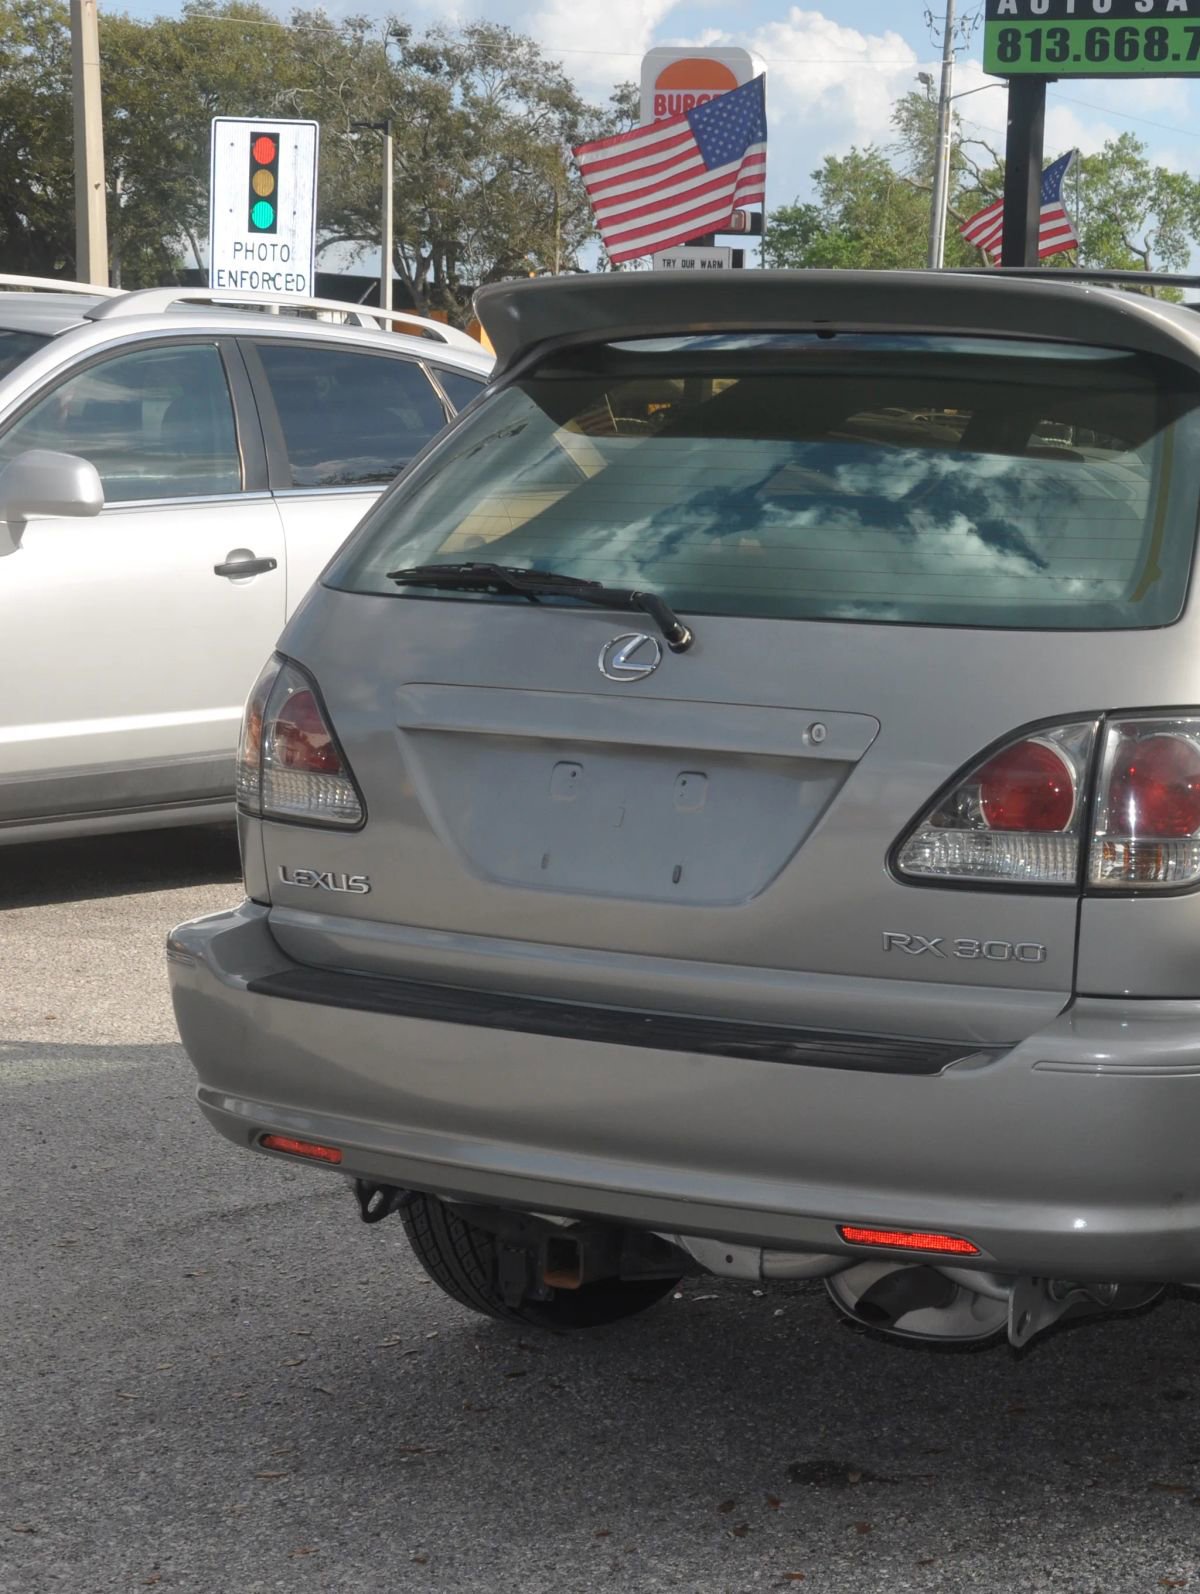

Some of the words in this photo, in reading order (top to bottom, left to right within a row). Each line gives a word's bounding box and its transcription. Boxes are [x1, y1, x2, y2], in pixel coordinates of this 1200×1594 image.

[653, 93, 724, 116] BUR
[233, 242, 290, 262] PHOTO
[662, 258, 677, 269] TRY
[681, 259, 696, 269] OUR
[700, 260, 724, 269] WARM
[217, 269, 306, 292] ENFORCED
[279, 865, 371, 895] LEXUS
[882, 931, 948, 959] RX
[952, 938, 1048, 964] 300
